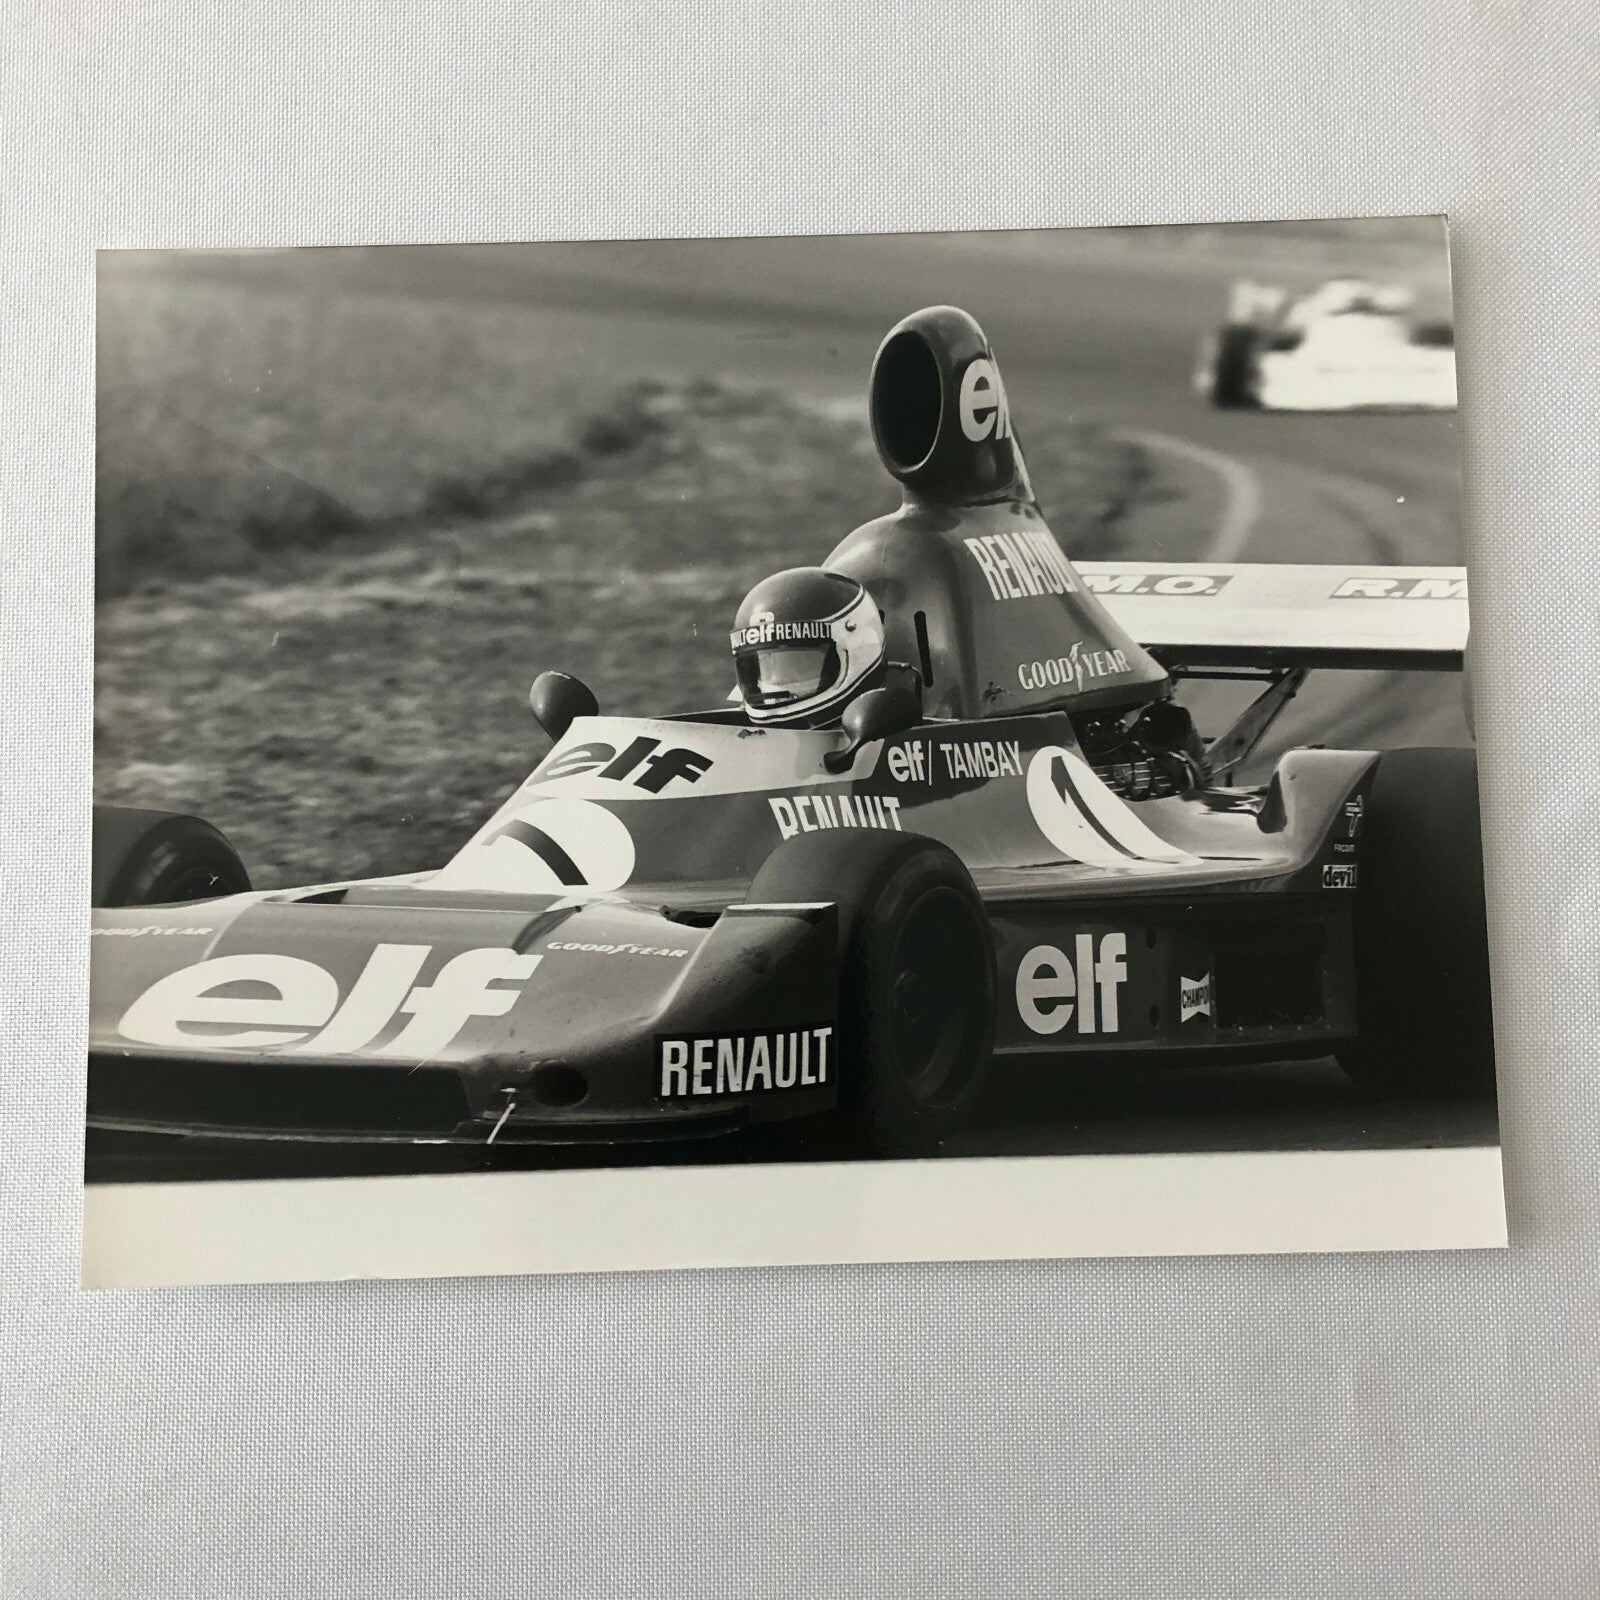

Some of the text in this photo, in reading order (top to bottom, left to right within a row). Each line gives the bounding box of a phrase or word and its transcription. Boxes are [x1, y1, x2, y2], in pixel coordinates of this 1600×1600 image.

[746, 623, 775, 645] elf
[776, 622, 831, 641] RENAULT
[526, 736, 714, 794] elf
[940, 741, 1023, 780] TAMBAY
[1323, 866, 1356, 887] devil
[546, 941, 689, 958] GOODYEAR
[117, 943, 543, 1056] elf
[1015, 933, 1127, 1034] elf
[661, 1027, 833, 1097] RENAULT
